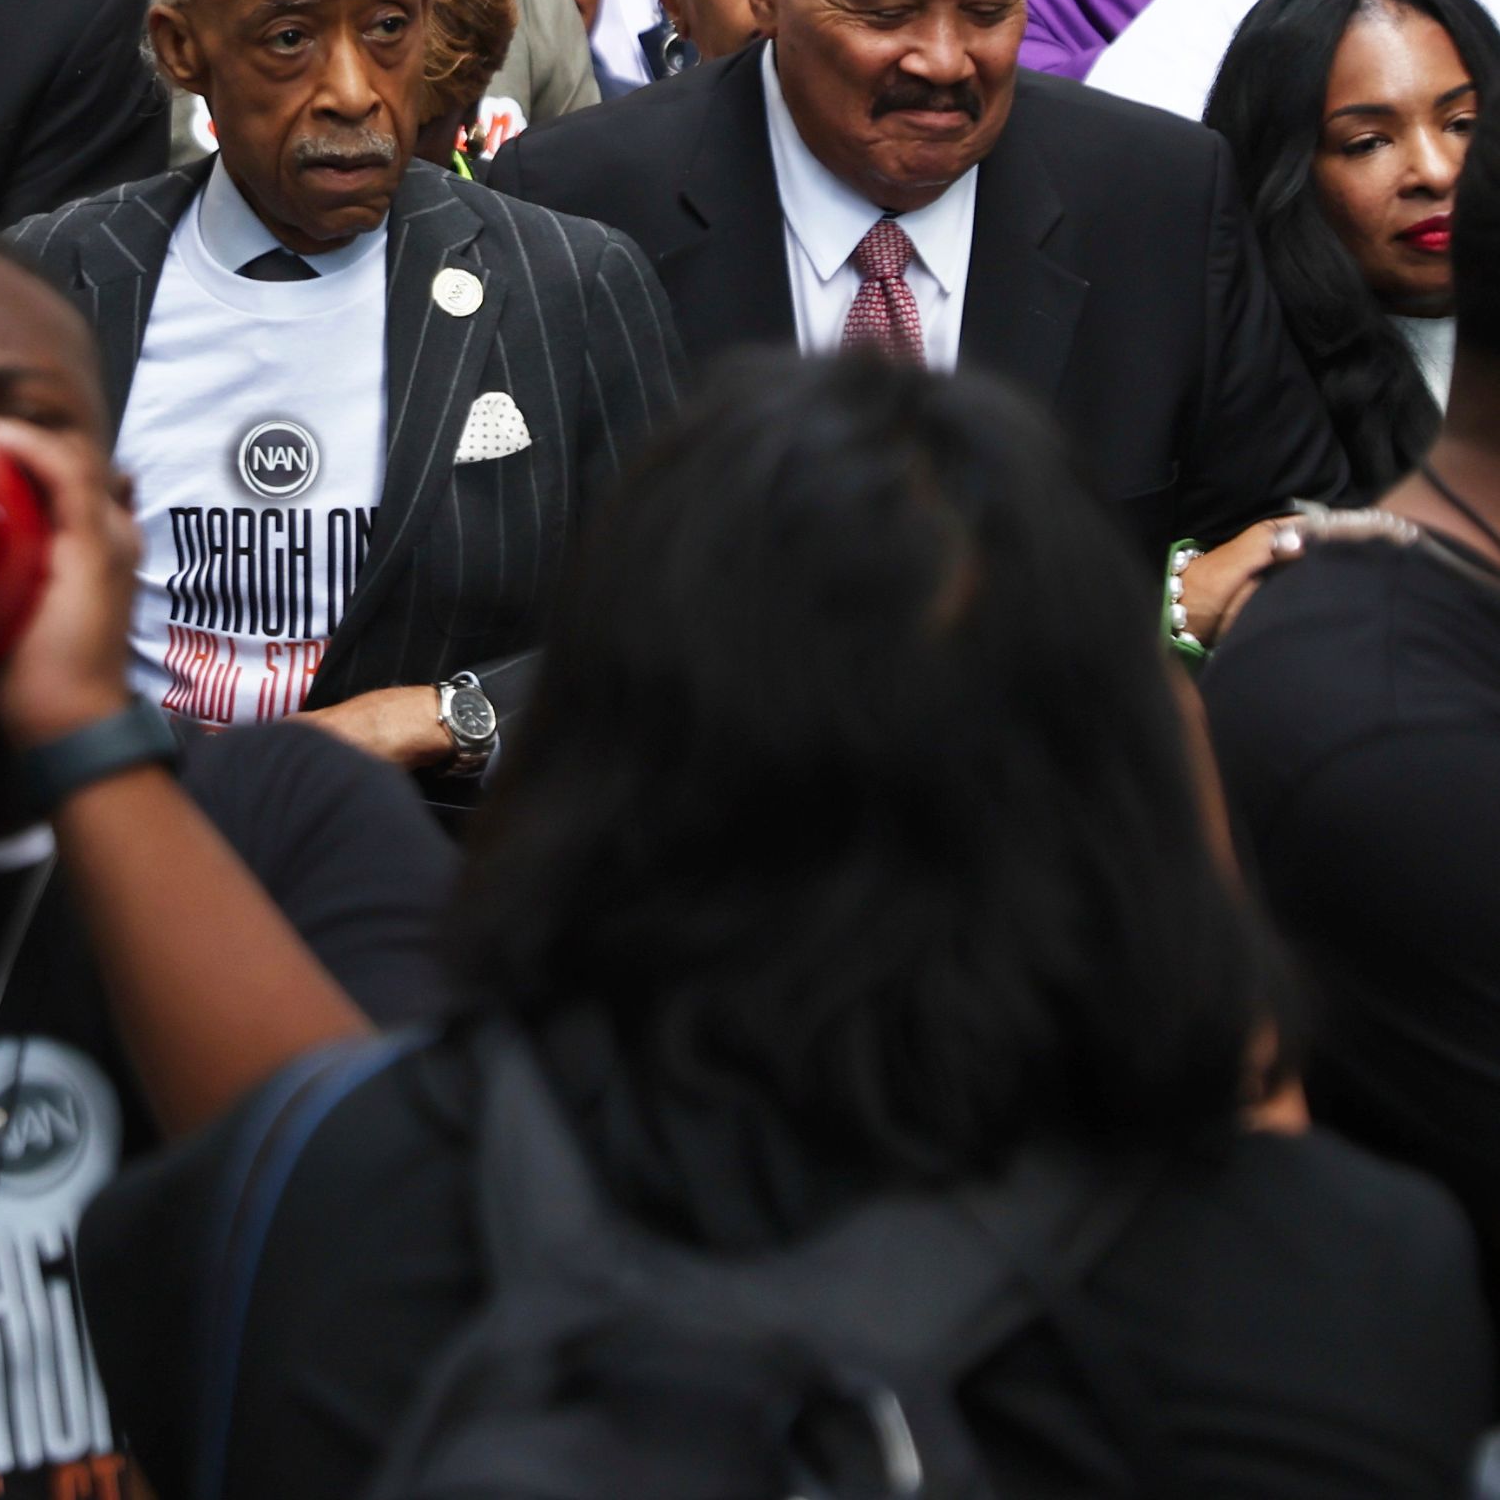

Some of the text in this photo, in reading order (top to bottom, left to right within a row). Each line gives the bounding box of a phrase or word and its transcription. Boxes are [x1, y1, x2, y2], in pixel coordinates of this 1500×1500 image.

[252, 445, 308, 472] NAN
[167, 506, 312, 639] MARCH
[161, 623, 242, 724] WALL
[256, 638, 332, 724] STR
